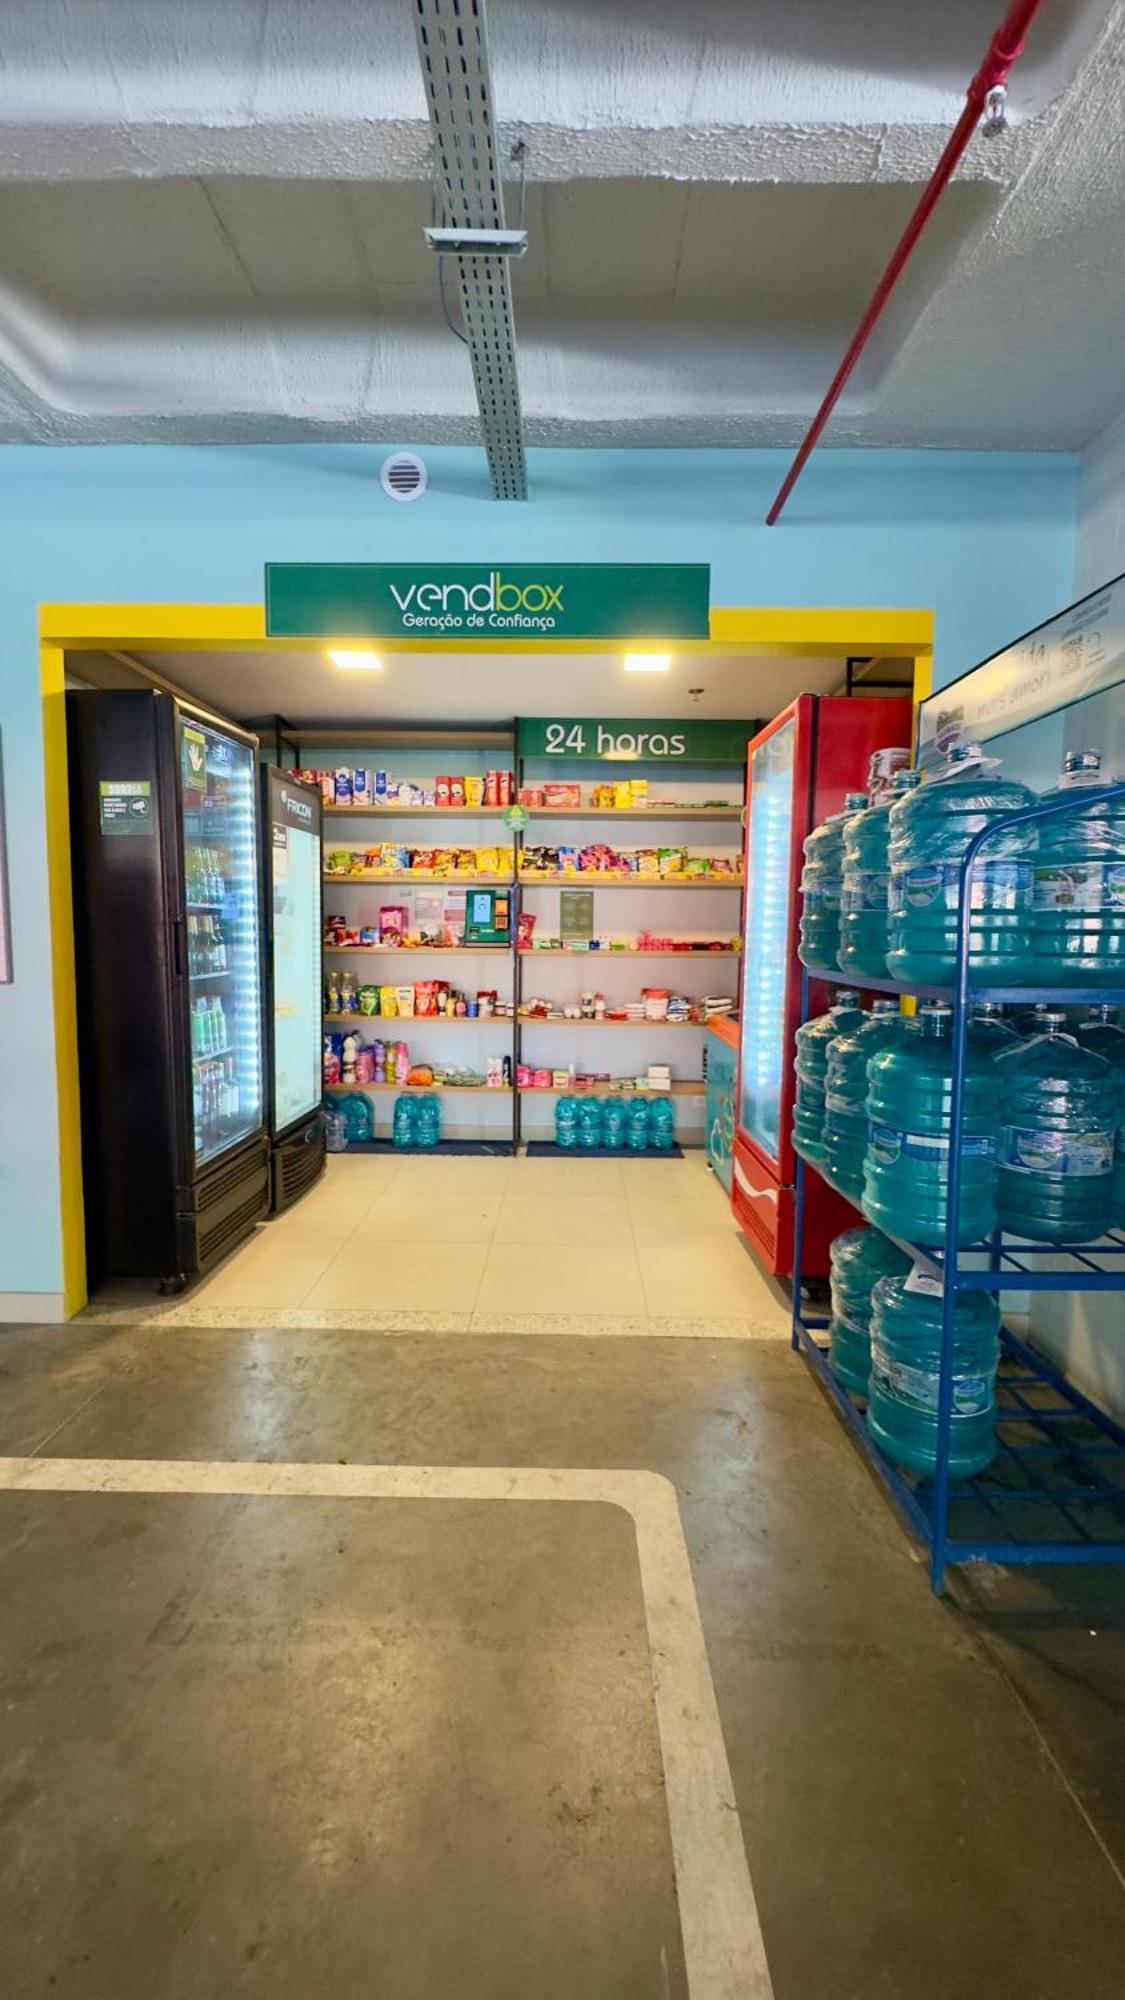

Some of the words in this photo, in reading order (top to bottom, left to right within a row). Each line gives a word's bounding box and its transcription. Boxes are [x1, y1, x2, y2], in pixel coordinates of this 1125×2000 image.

[390, 571, 564, 611] vendbox
[402, 613, 463, 630] Geração
[466, 614, 485, 627] de
[488, 613, 556, 631] Confiança
[545, 723, 586, 753] 24
[597, 725, 686, 755] horas
